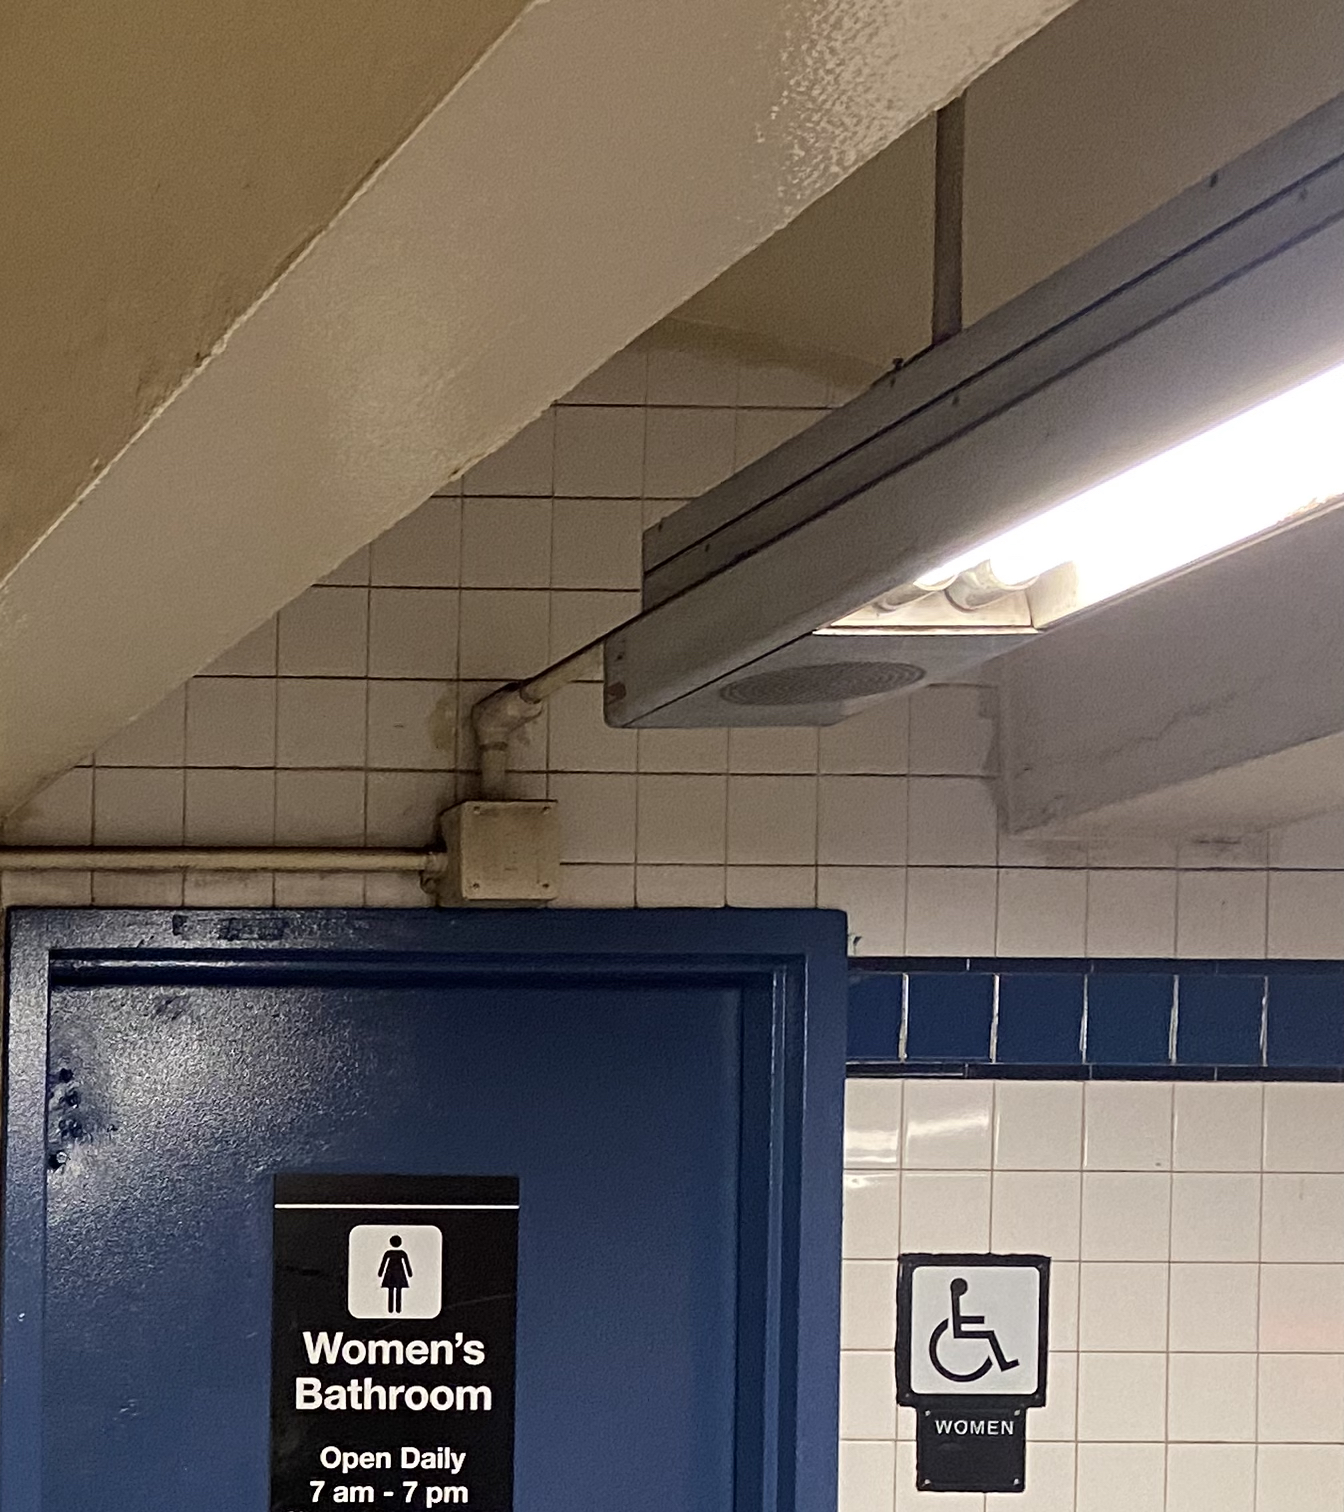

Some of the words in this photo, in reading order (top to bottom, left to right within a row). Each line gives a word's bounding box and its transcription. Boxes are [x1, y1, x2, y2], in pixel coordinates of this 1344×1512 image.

[302, 1331, 485, 1366] Women's
[294, 1377, 493, 1412] Bathroom
[935, 1420, 1014, 1435] WOMEN
[320, 1446, 391, 1474] Open
[401, 1447, 466, 1474] Daily
[309, 1480, 326, 1503] 7
[333, 1484, 374, 1504] am
[402, 1480, 418, 1503] 7
[425, 1484, 469, 1508] pm
